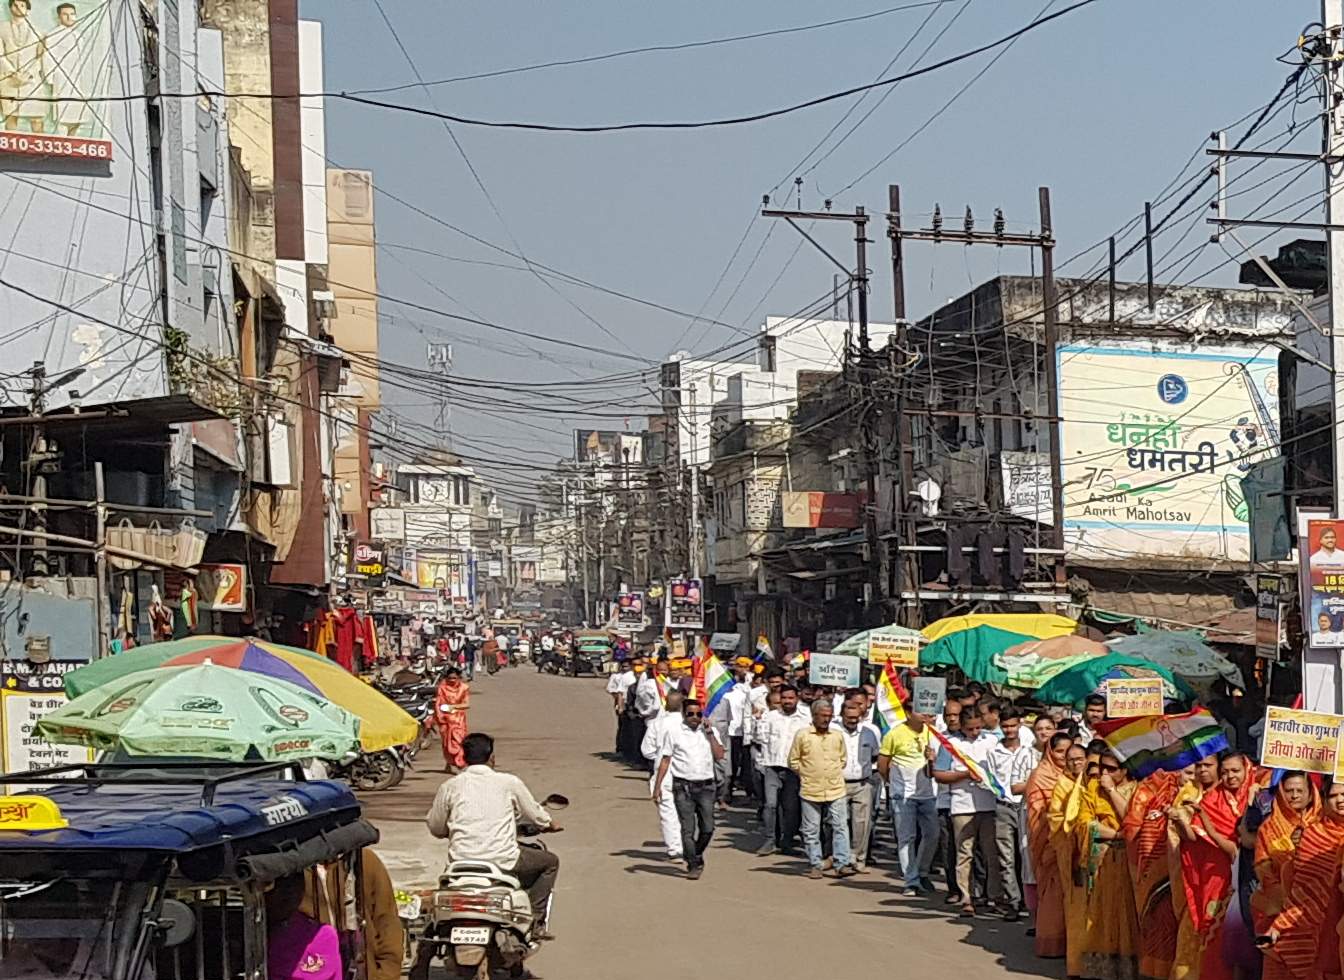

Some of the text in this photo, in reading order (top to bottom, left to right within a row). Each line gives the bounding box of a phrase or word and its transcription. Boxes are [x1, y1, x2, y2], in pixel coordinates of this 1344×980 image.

[1126, 441, 1218, 474] धमतरी
[1083, 505, 1191, 522] Amrit Mahotsav
